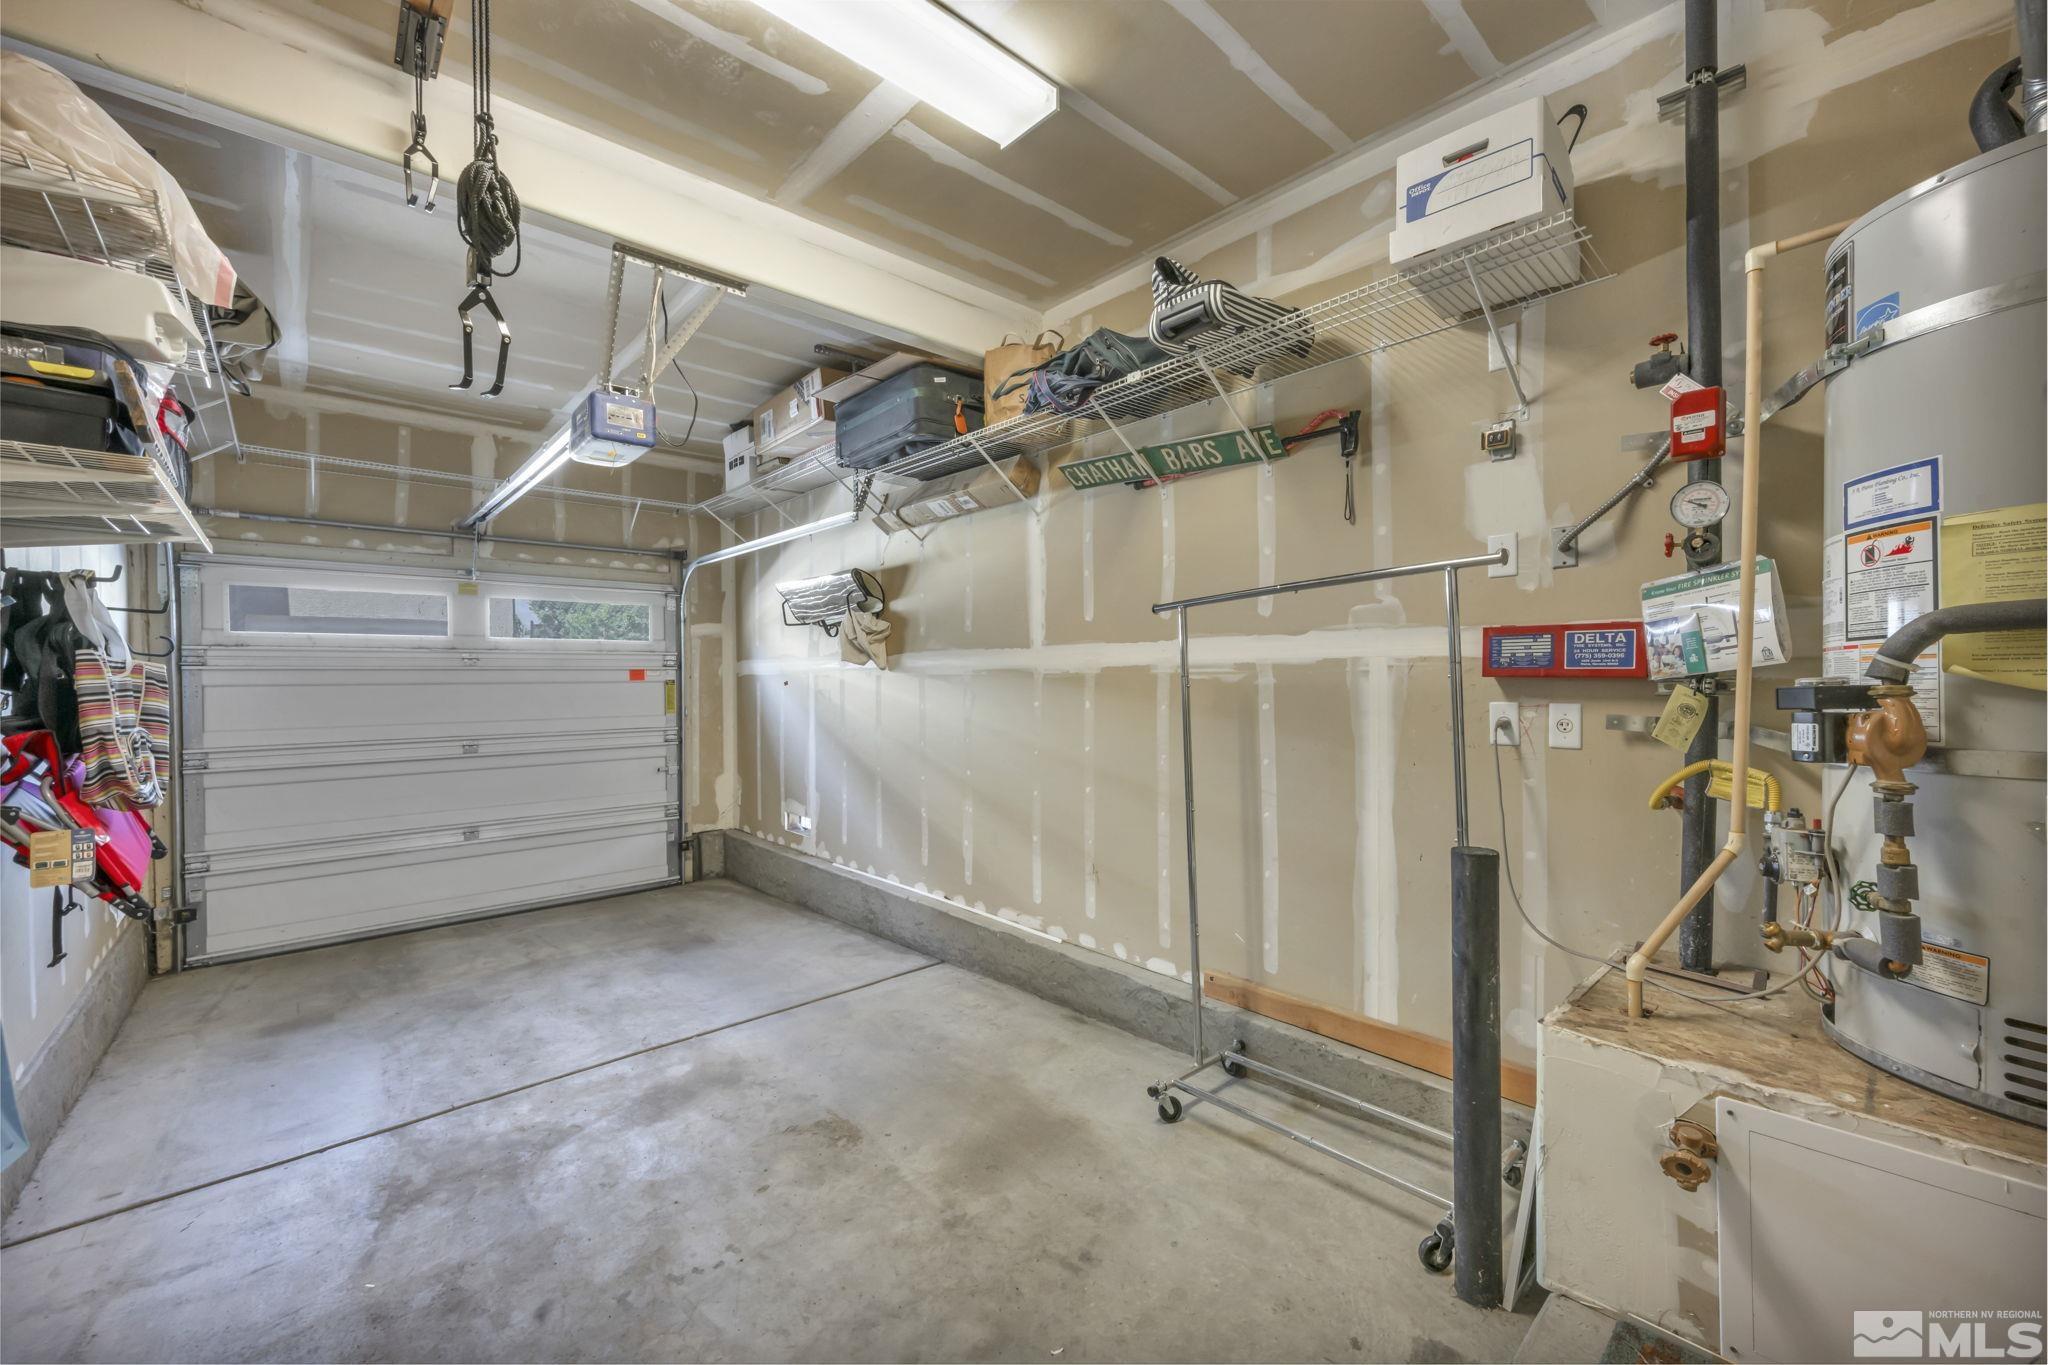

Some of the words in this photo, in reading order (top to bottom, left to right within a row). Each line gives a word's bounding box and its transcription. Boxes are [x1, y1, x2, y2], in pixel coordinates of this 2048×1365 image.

[1409, 182, 1431, 194] Office
[1160, 440, 1223, 470] BARS
[1872, 529, 1898, 539] WARNING
[1677, 580, 1691, 590] FIRE
[1574, 632, 1627, 644] DELTA
[1926, 945, 1962, 959] WARNING
